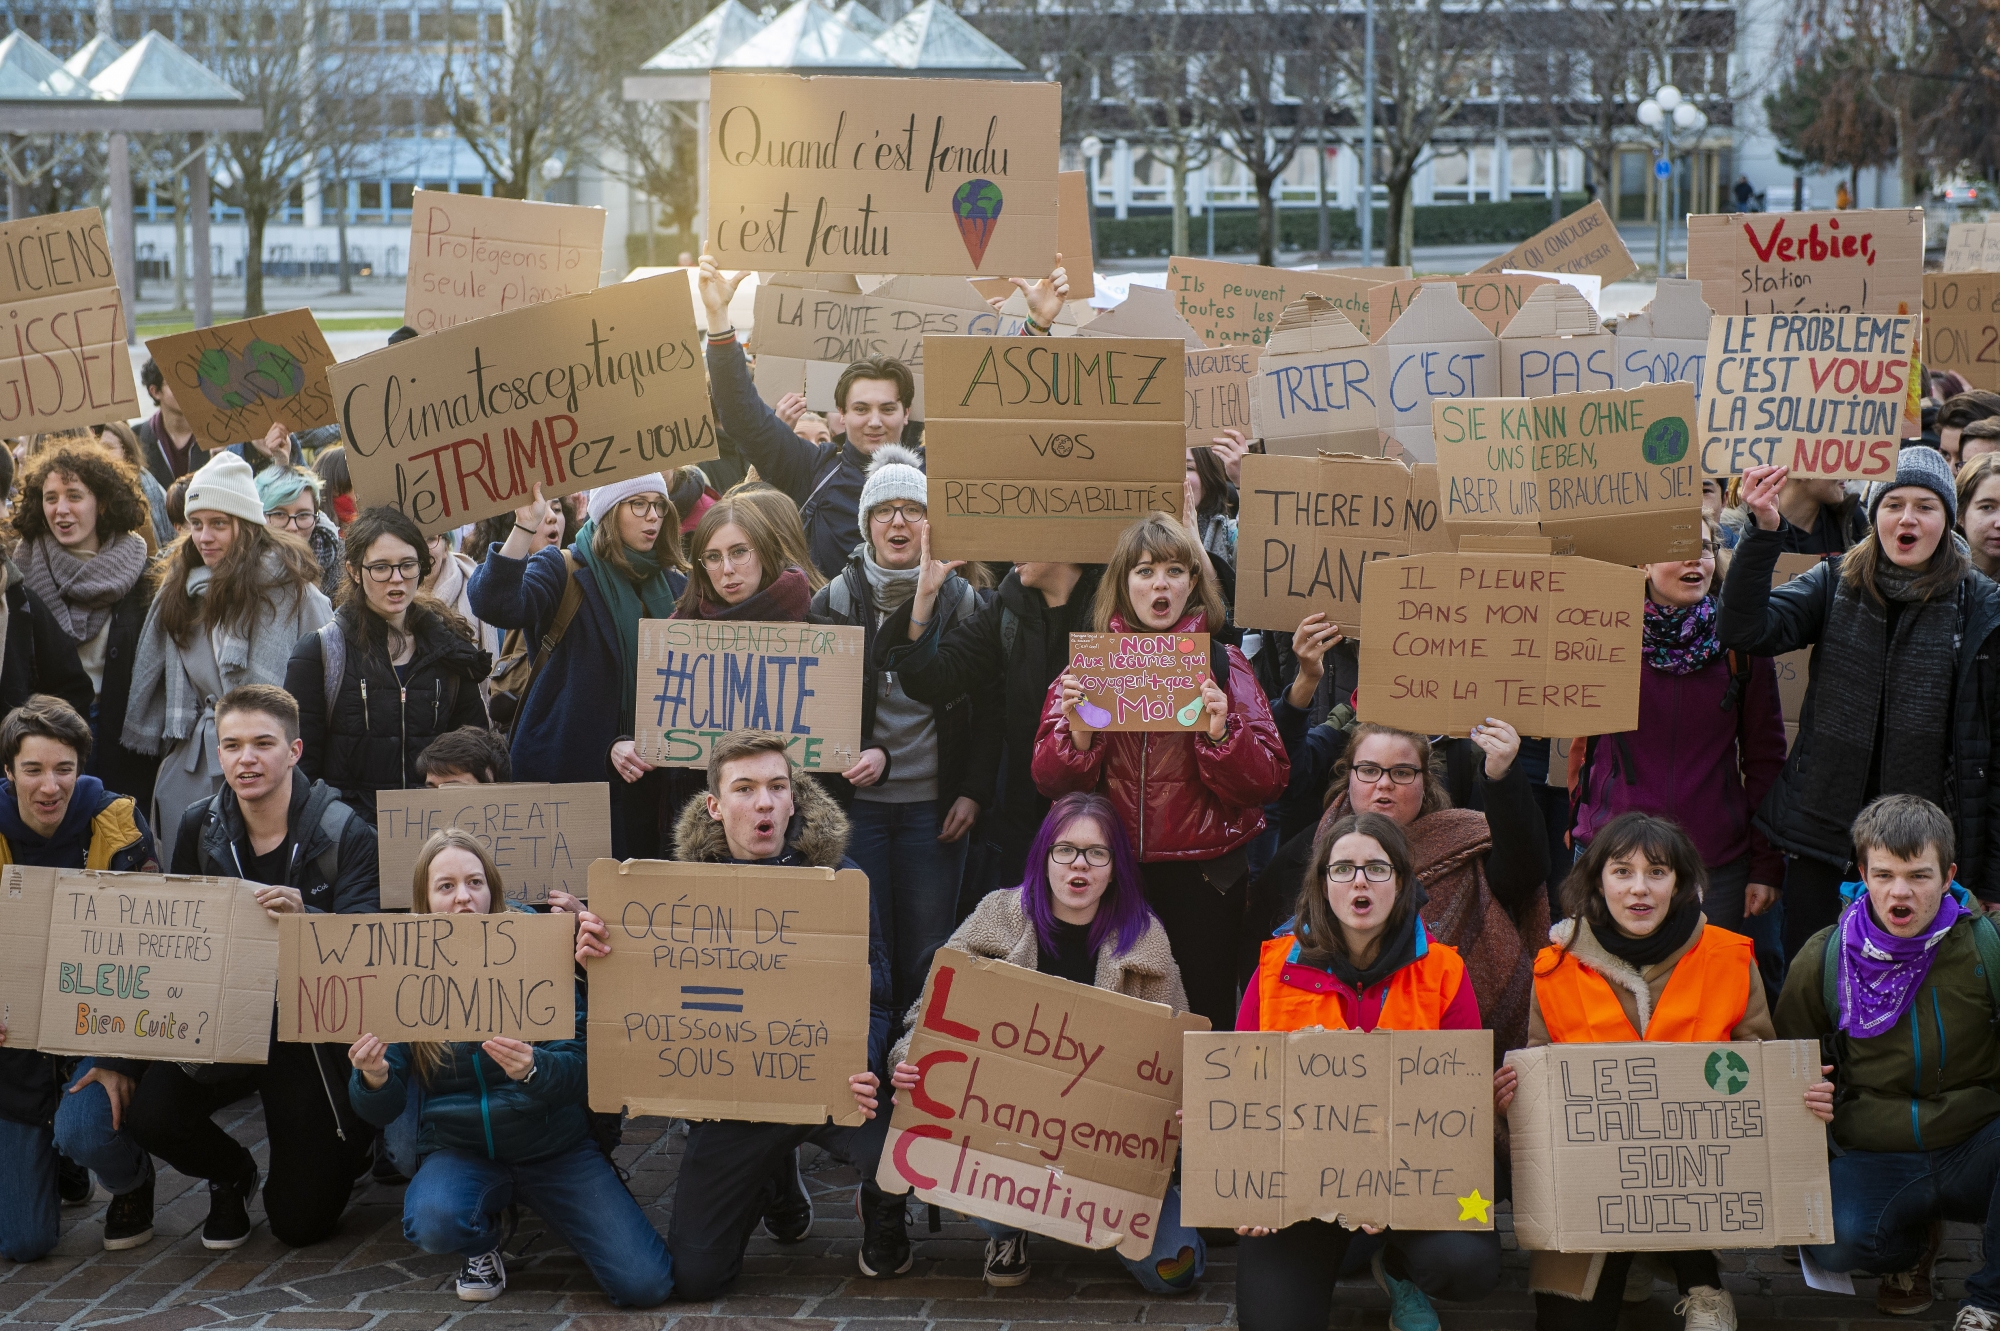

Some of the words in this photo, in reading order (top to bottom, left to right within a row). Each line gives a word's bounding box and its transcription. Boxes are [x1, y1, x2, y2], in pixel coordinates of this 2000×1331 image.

[718, 105, 847, 169] Quand
[853, 112, 920, 171] c'est
[925, 115, 1009, 193] fondu
[427, 206, 548, 275] Protégeons
[557, 229, 581, 272] la
[717, 192, 798, 254] c'est
[805, 193, 890, 268] foutu
[1524, 247, 1545, 269] OU
[1544, 212, 1604, 257] CONDUIRE
[1743, 217, 1876, 266] Verbier,
[423, 271, 487, 298] seule
[1223, 284, 1286, 302] peuvent
[1741, 265, 1812, 293] Station
[777, 293, 803, 326] LA
[814, 300, 883, 335] FONTE
[890, 310, 959, 334] DES
[1180, 296, 1235, 319] toutes
[1253, 303, 1274, 322] les
[814, 336, 888, 362] DANS
[1723, 316, 1757, 355] LE
[1767, 315, 1911, 355] PROBLEME
[1975, 325, 2000, 364] 2
[959, 346, 1167, 407] ASSUMEZ
[1185, 354, 1252, 377] NQUISE
[1266, 358, 1376, 419] TRIER
[1389, 350, 1486, 412] C'EST
[1520, 349, 1614, 397] PAS
[1716, 357, 1799, 395] C'EST
[1808, 357, 1908, 395] VOUS
[343, 318, 695, 457] Climatosceptiques
[1211, 381, 1251, 428] L'EAU
[1442, 406, 1486, 443] SIE
[1501, 402, 1577, 441] KANN
[1579, 399, 1645, 436] OHNE
[1708, 397, 1746, 433] LA
[1029, 433, 1095, 460] VOS
[1487, 444, 1525, 472] UNS
[1531, 443, 1598, 473] LEBEN,
[1701, 437, 1782, 475] C'EST
[1792, 438, 1893, 476] NOUS
[945, 481, 1177, 515] RESPONSABILITÉS
[1448, 475, 1501, 515] ABER
[1510, 478, 1541, 515] WIR
[1550, 474, 1649, 512] BRAUCHEN
[1657, 464, 1694, 501] SIE!
[1255, 489, 1361, 527] THERE
[1372, 494, 1395, 528] IS
[1404, 499, 1438, 532] NO
[1263, 538, 1409, 604] PLAN
[1399, 566, 1437, 590] IL
[1459, 567, 1567, 593] PLEURE
[1398, 600, 1468, 624] DANS
[1485, 604, 1538, 625] MON
[1556, 609, 1632, 629] COEUR
[667, 622, 788, 653] STUDENTS
[797, 629, 837, 655] FOR
[1120, 635, 1176, 656] NON
[1392, 631, 1488, 659] COMME
[1511, 638, 1541, 659] IL
[1554, 637, 1626, 664] BRÛLE
[1072, 653, 1104, 669] Aux
[1180, 652, 1207, 671] qui
[653, 650, 819, 735] #CLIMATE
[1165, 674, 1195, 692] que
[1390, 674, 1439, 700] SUR
[1453, 680, 1478, 699] LA
[1495, 679, 1607, 708] TERRE
[1117, 695, 1175, 725] Moi
[378, 806, 442, 840] THE
[453, 802, 569, 835] GREAT
[69, 893, 97, 921] TA
[119, 894, 208, 933] PLANETE,
[622, 894, 733, 944] OCÉAN
[755, 908, 800, 945] DE
[81, 930, 103, 954] TU
[108, 932, 124, 956] LA
[138, 932, 212, 962] PREFERES
[309, 919, 457, 967] WINTER
[482, 919, 517, 966] IS
[653, 945, 788, 971] PLASTIQUE
[59, 961, 150, 999] BLEUE
[75, 1003, 126, 1035] Bien
[134, 1009, 189, 1039] Cuite
[298, 974, 377, 1035] NOT
[395, 973, 556, 1033] COMING
[624, 1012, 757, 1043] POISSONS
[768, 1018, 829, 1048] DÉJÀ
[922, 965, 1105, 1098] Lobby
[1136, 1050, 1174, 1085] du
[658, 1047, 734, 1078] SOUS
[752, 1051, 816, 1081] VIDE
[1204, 1045, 1268, 1081] S'il
[1298, 1053, 1367, 1078] vous
[1397, 1045, 1482, 1085] plaît...
[1560, 1057, 1659, 1102] LES
[909, 1049, 1179, 1163] Changement
[1209, 1100, 1378, 1134] DESSINE
[1565, 1100, 1763, 1142] CALOTTES
[892, 1124, 1151, 1243] Climatique
[1214, 1168, 1288, 1200] UNE
[1320, 1158, 1456, 1199] PLANÈTE
[1618, 1145, 1731, 1189] SONT
[1597, 1191, 1764, 1234] CUITES
